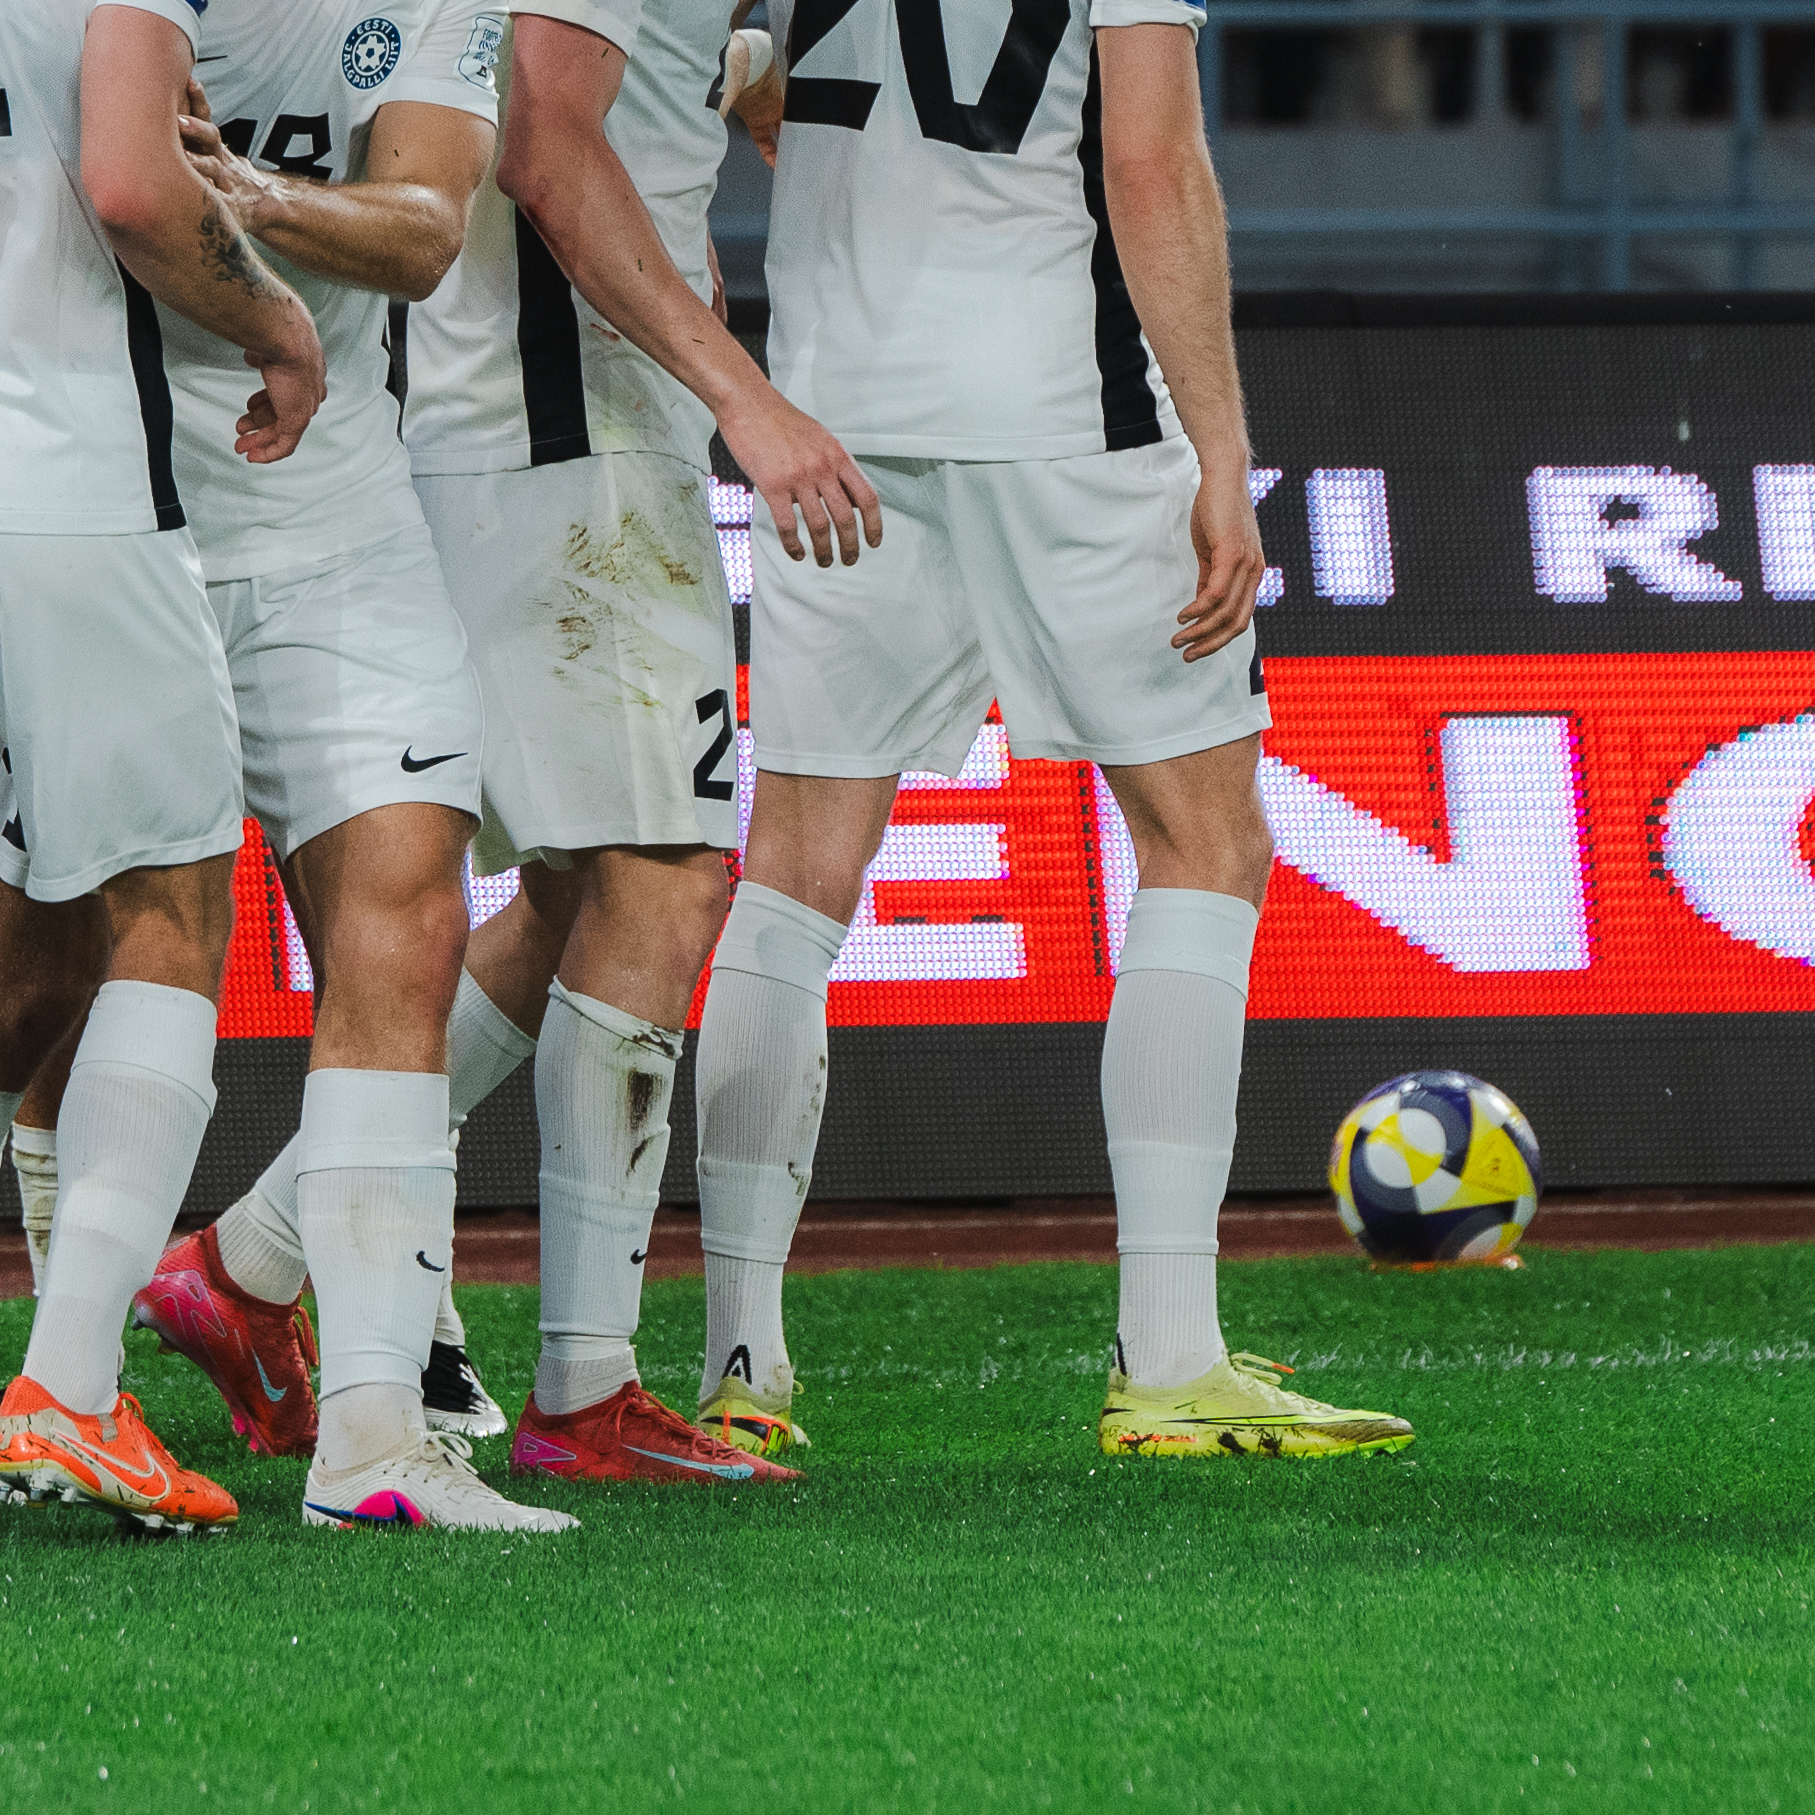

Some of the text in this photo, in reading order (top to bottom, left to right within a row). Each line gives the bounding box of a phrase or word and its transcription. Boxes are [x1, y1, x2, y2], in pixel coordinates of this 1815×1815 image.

[356, 19, 393, 35] EESTI
[344, 40, 400, 88] JALGPALLI LIIT
